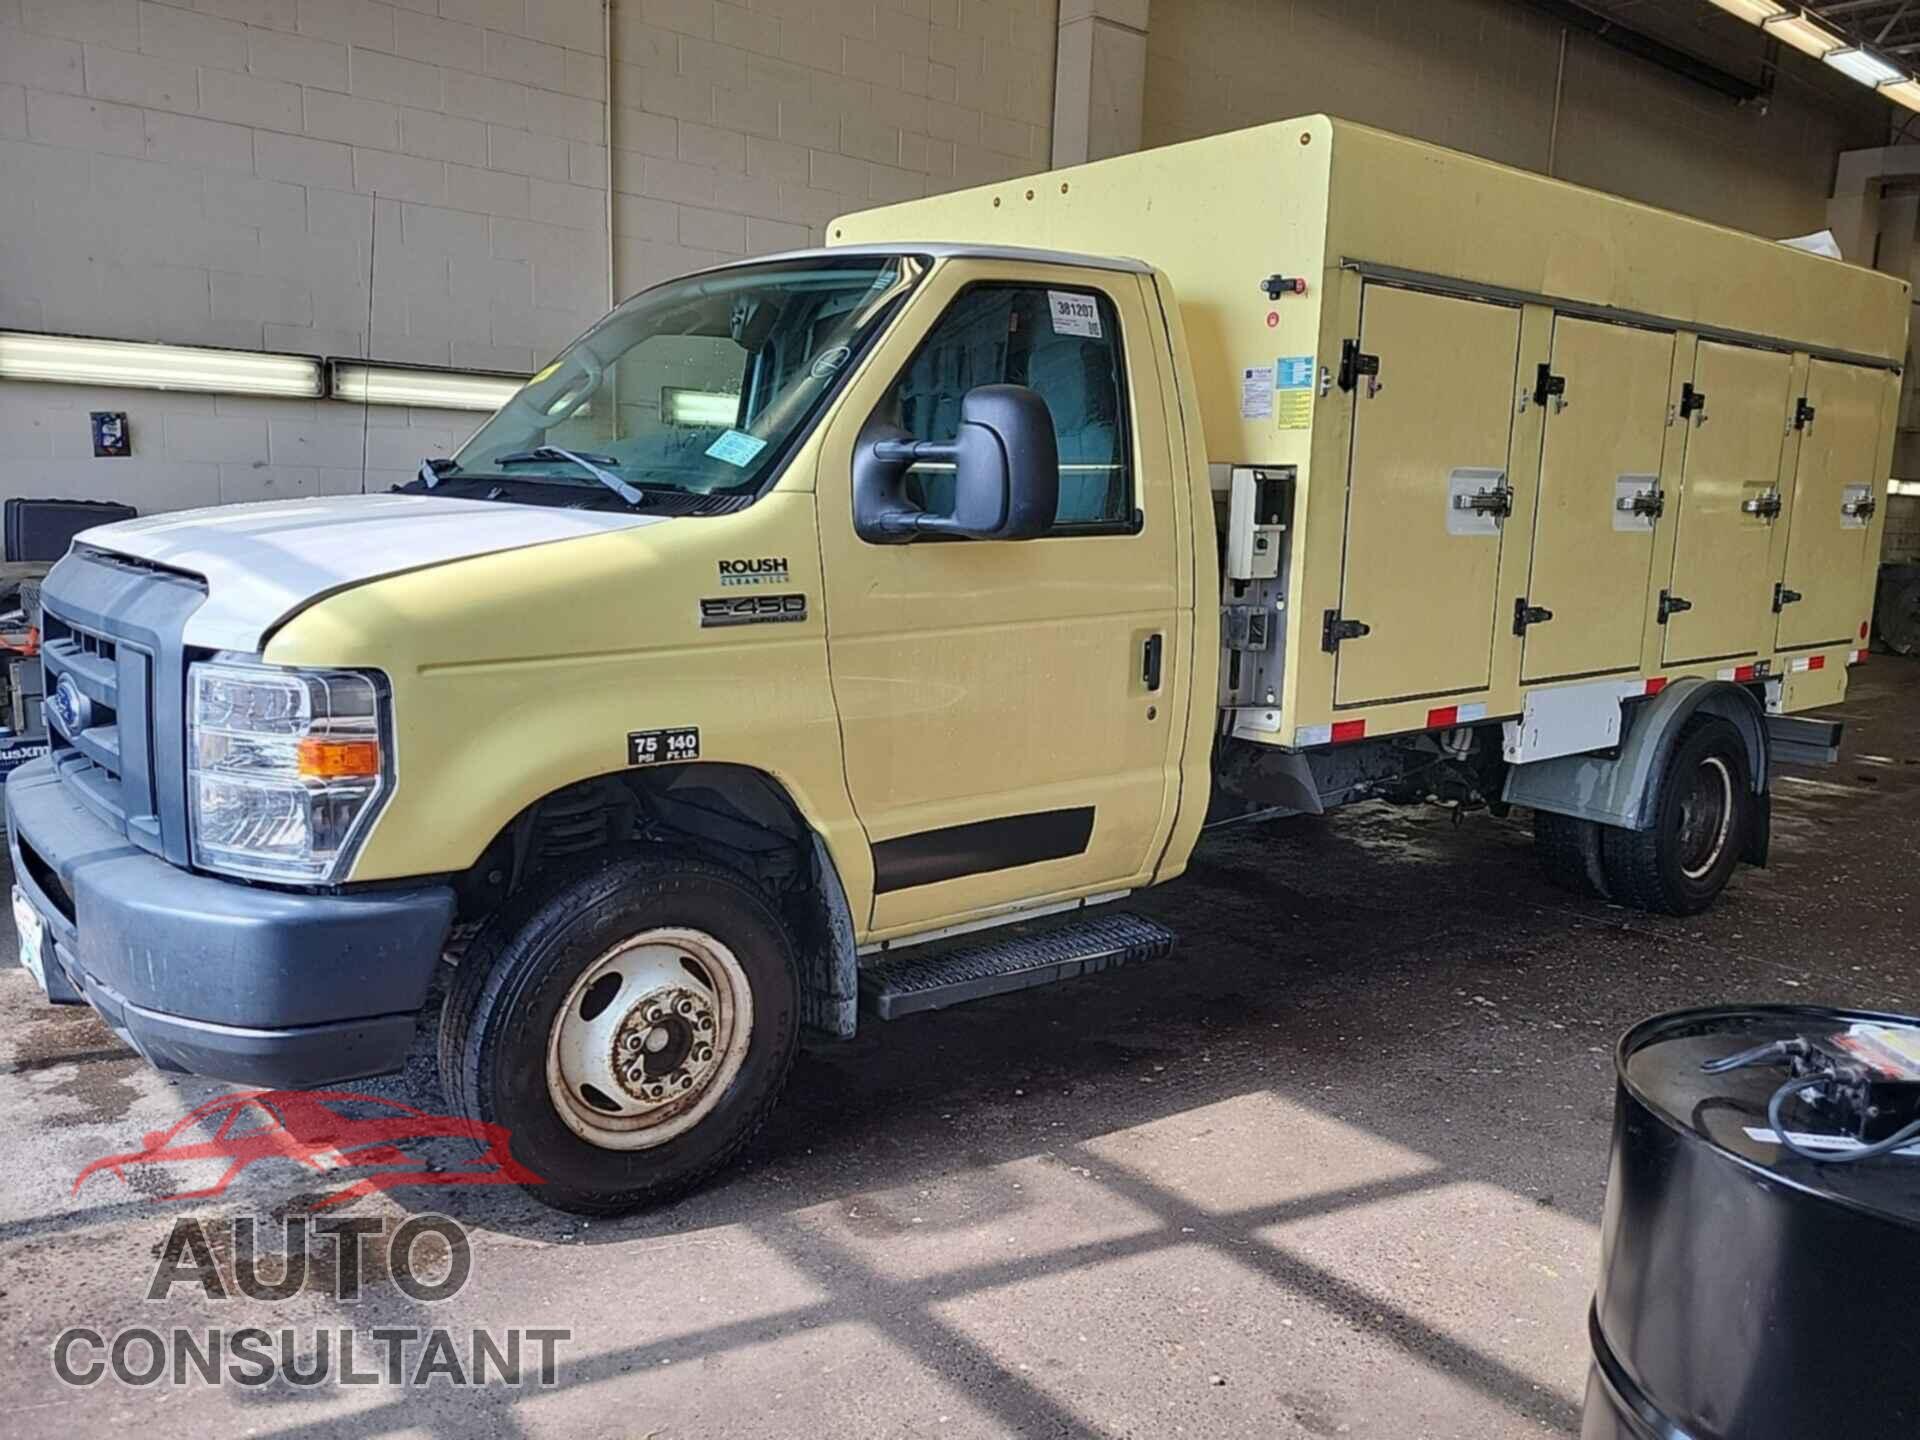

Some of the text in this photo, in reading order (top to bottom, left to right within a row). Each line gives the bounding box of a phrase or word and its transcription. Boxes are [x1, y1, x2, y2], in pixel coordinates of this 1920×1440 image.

[719, 558, 788, 575] ROUSH
[635, 737, 657, 753] 75
[667, 735, 697, 750] 140
[638, 753, 655, 763] PSI
